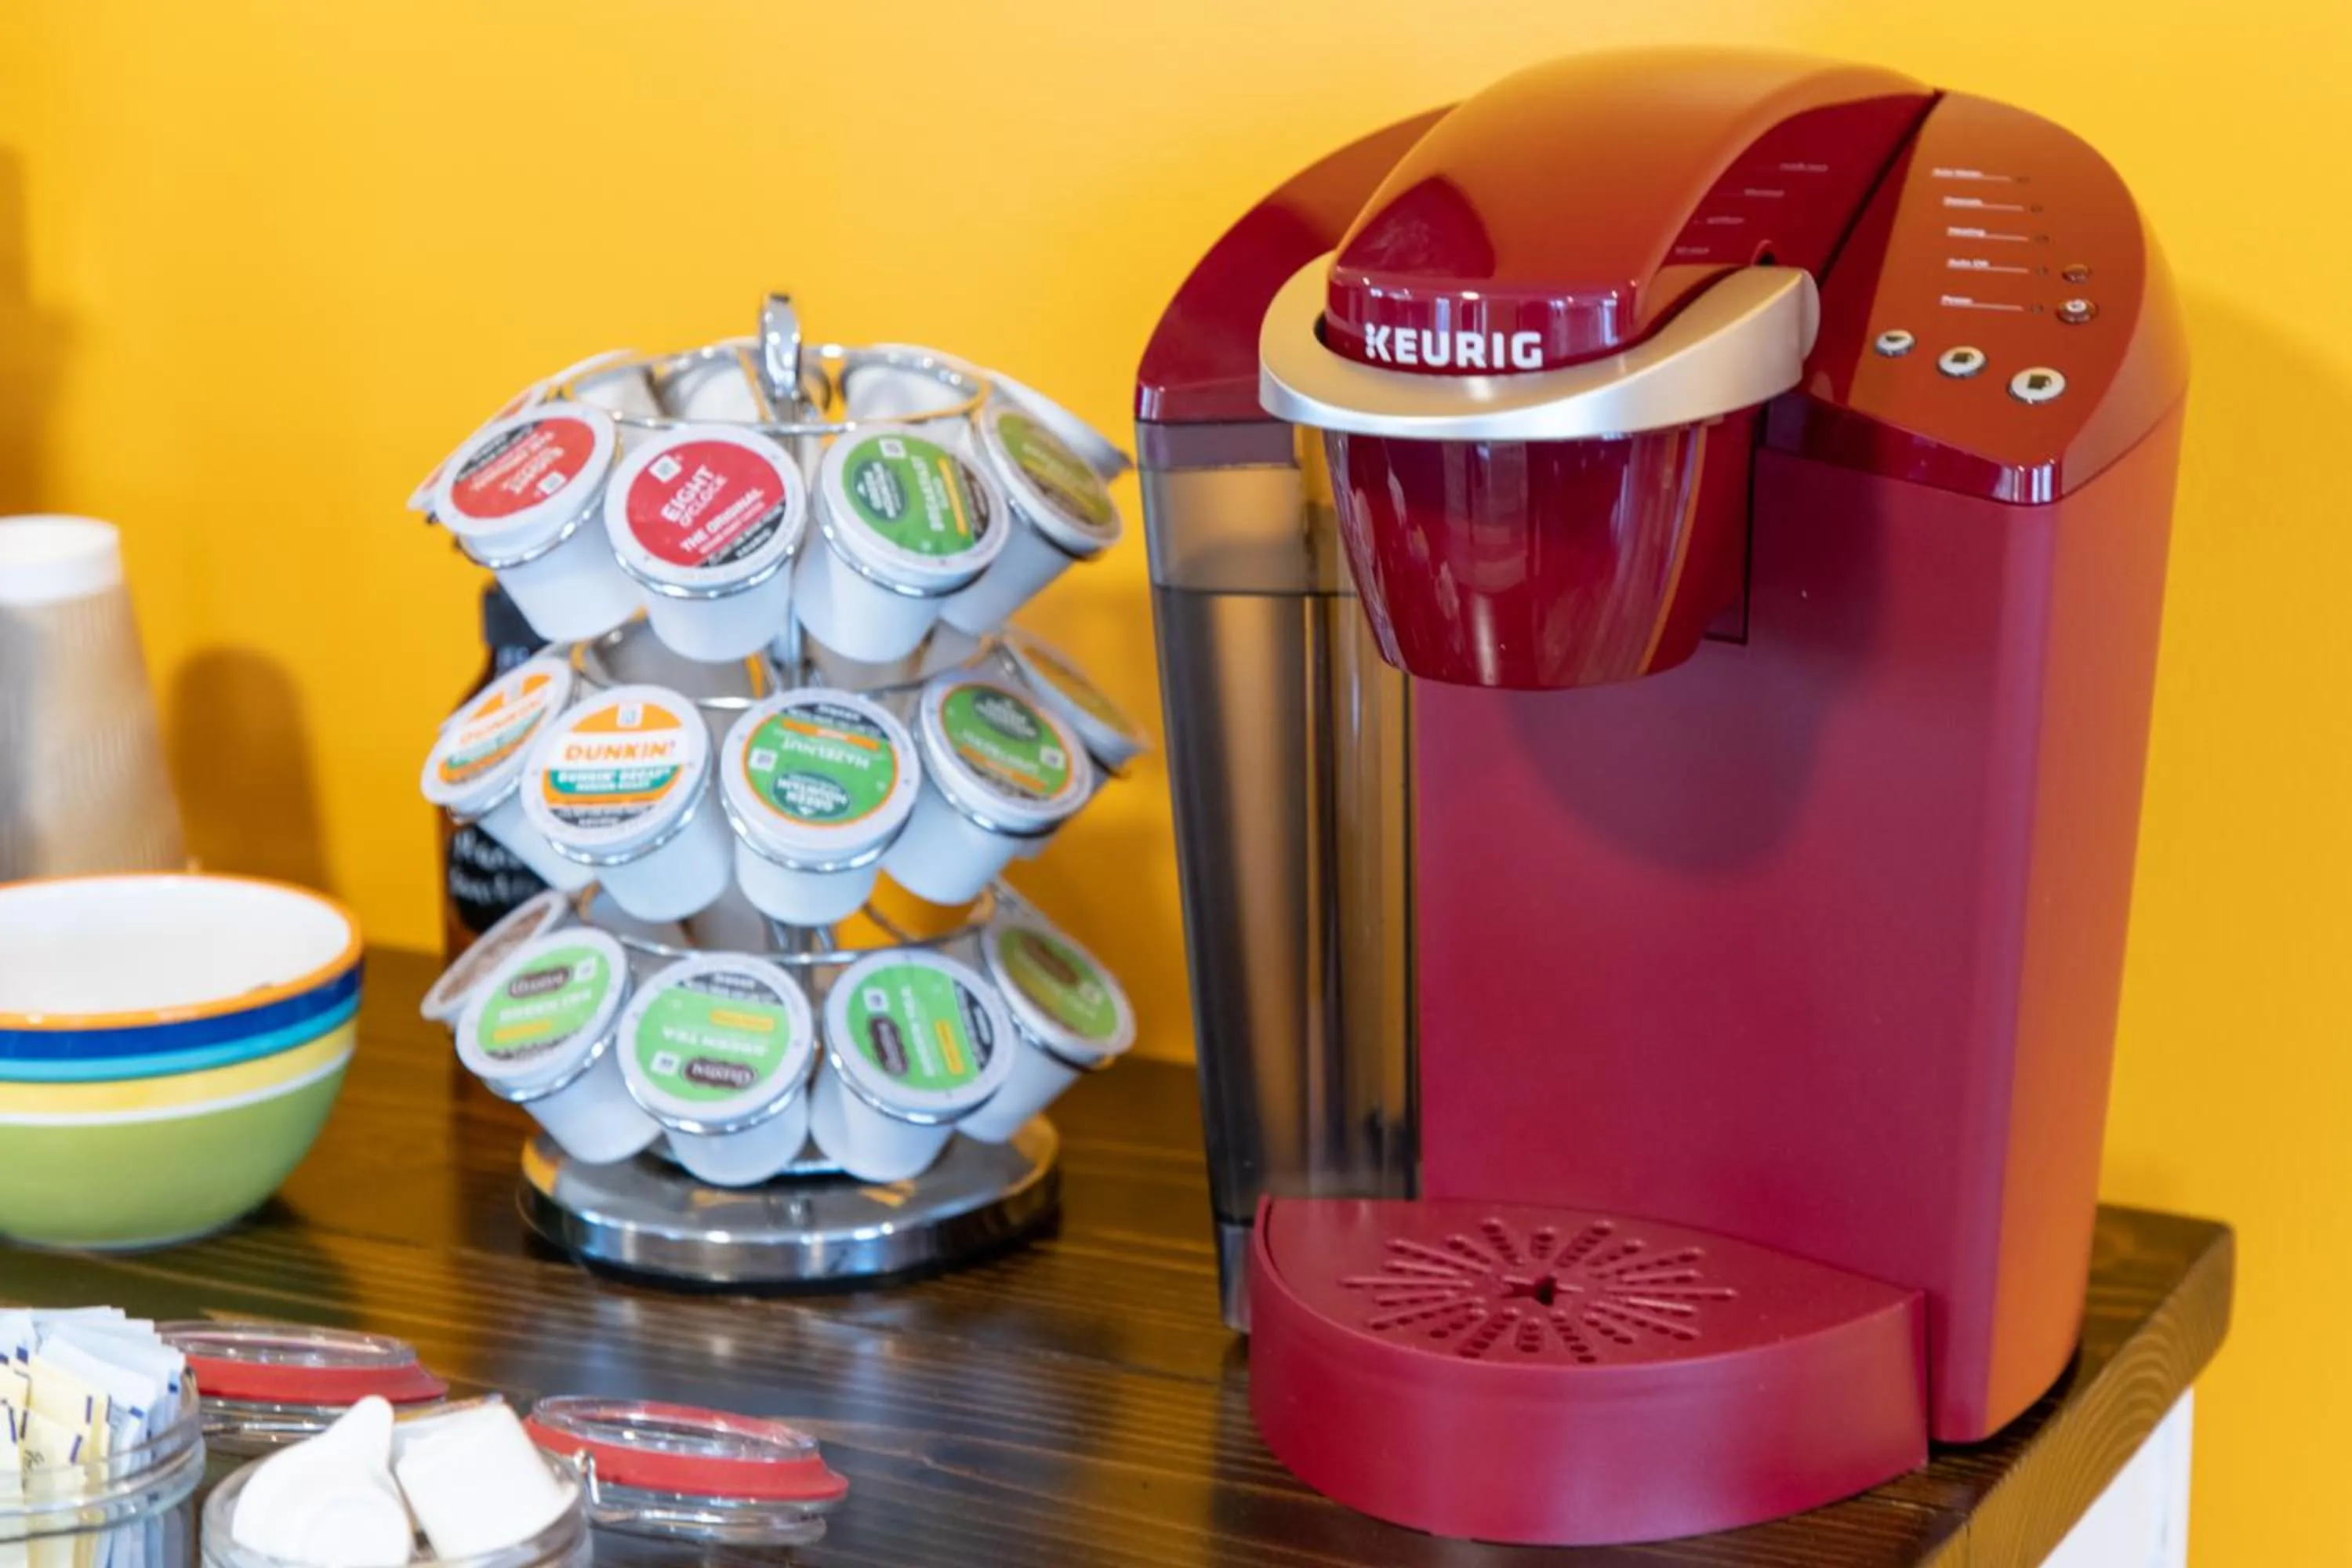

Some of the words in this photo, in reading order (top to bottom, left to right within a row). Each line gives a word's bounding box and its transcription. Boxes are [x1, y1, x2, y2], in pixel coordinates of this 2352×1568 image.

[1365, 323, 1543, 368] KEURIG
[660, 463, 715, 523] EIGHT
[680, 528, 709, 554] THE
[704, 483, 765, 535] ORIGINAL
[564, 740, 677, 760] DUNKIN'
[779, 736, 870, 769] HAZELNUT
